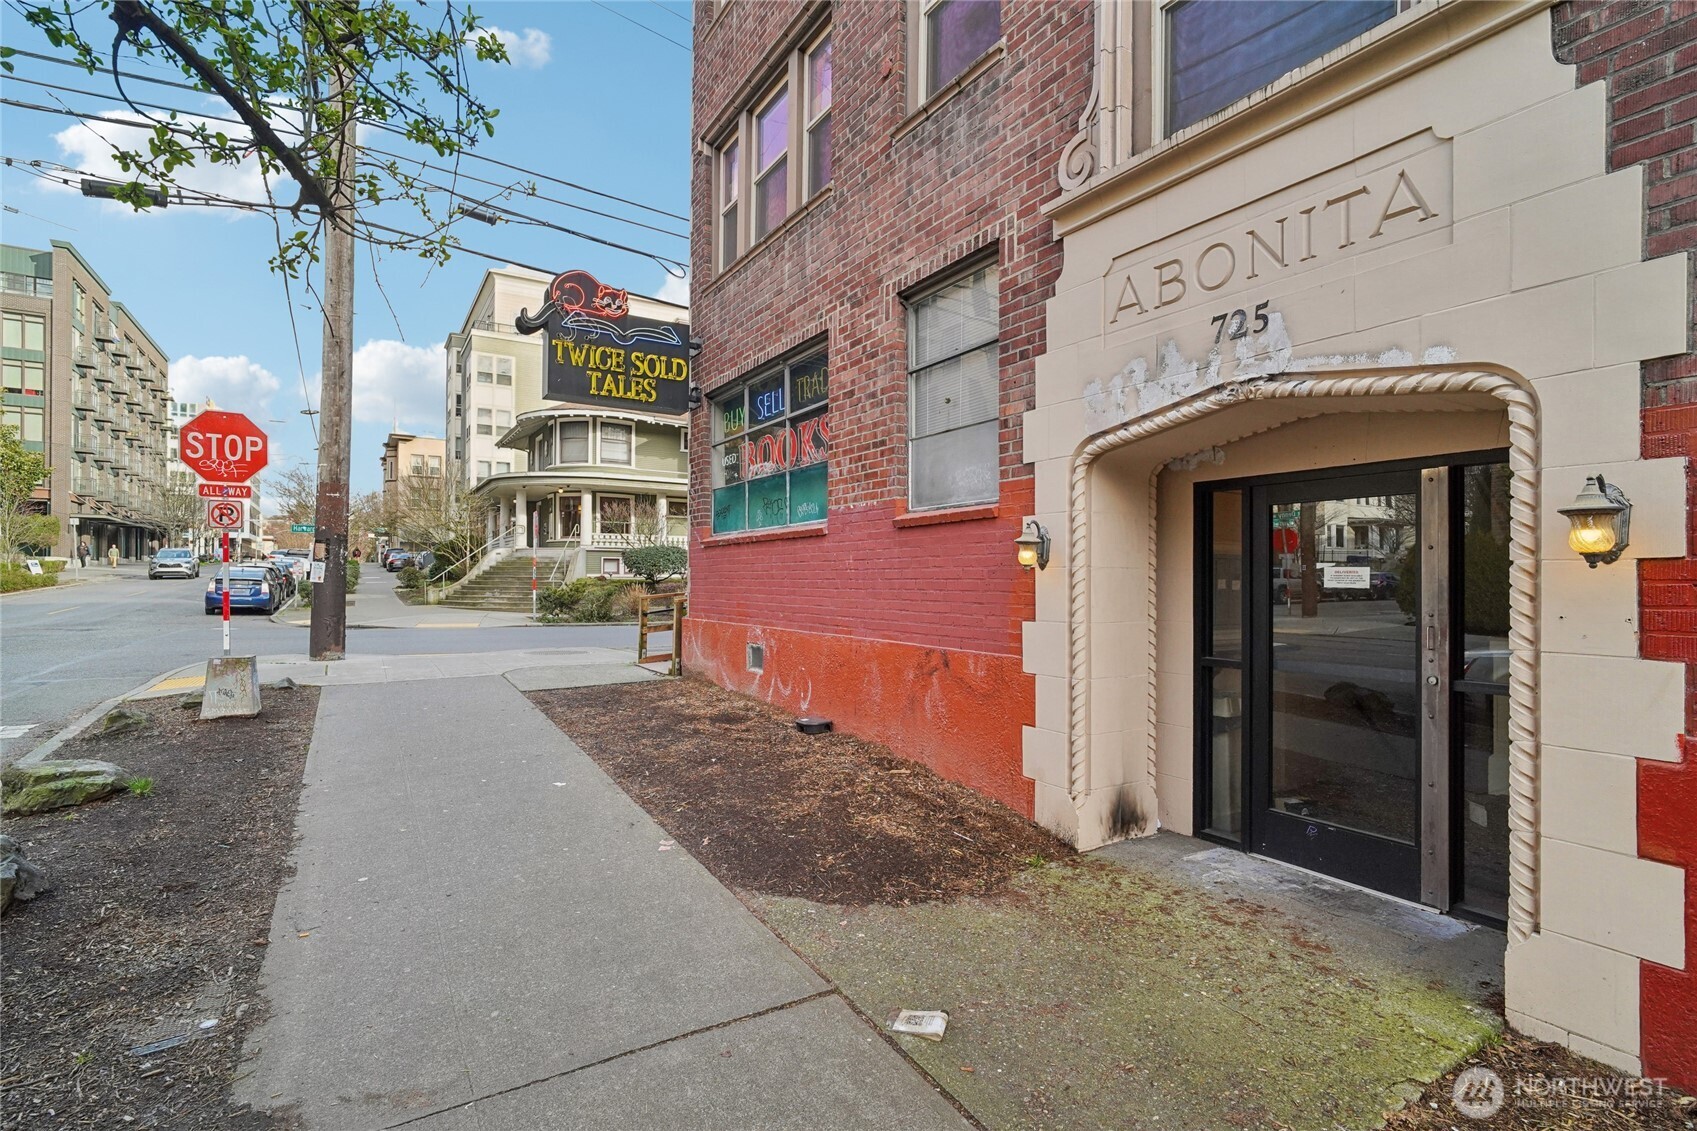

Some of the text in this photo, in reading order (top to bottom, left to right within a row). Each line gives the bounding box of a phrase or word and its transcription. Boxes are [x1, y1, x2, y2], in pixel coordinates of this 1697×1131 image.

[1109, 168, 1439, 324] ABONITA
[1210, 300, 1270, 344] 725
[552, 339, 688, 381] TWICE SOLD
[586, 370, 657, 402] TALES
[723, 406, 745, 433] BUY
[757, 387, 786, 420] SELL
[185, 431, 263, 462] STOP
[721, 453, 737, 467] USED
[738, 413, 829, 480] BOOKS
[202, 485, 248, 497] ALL WAY
